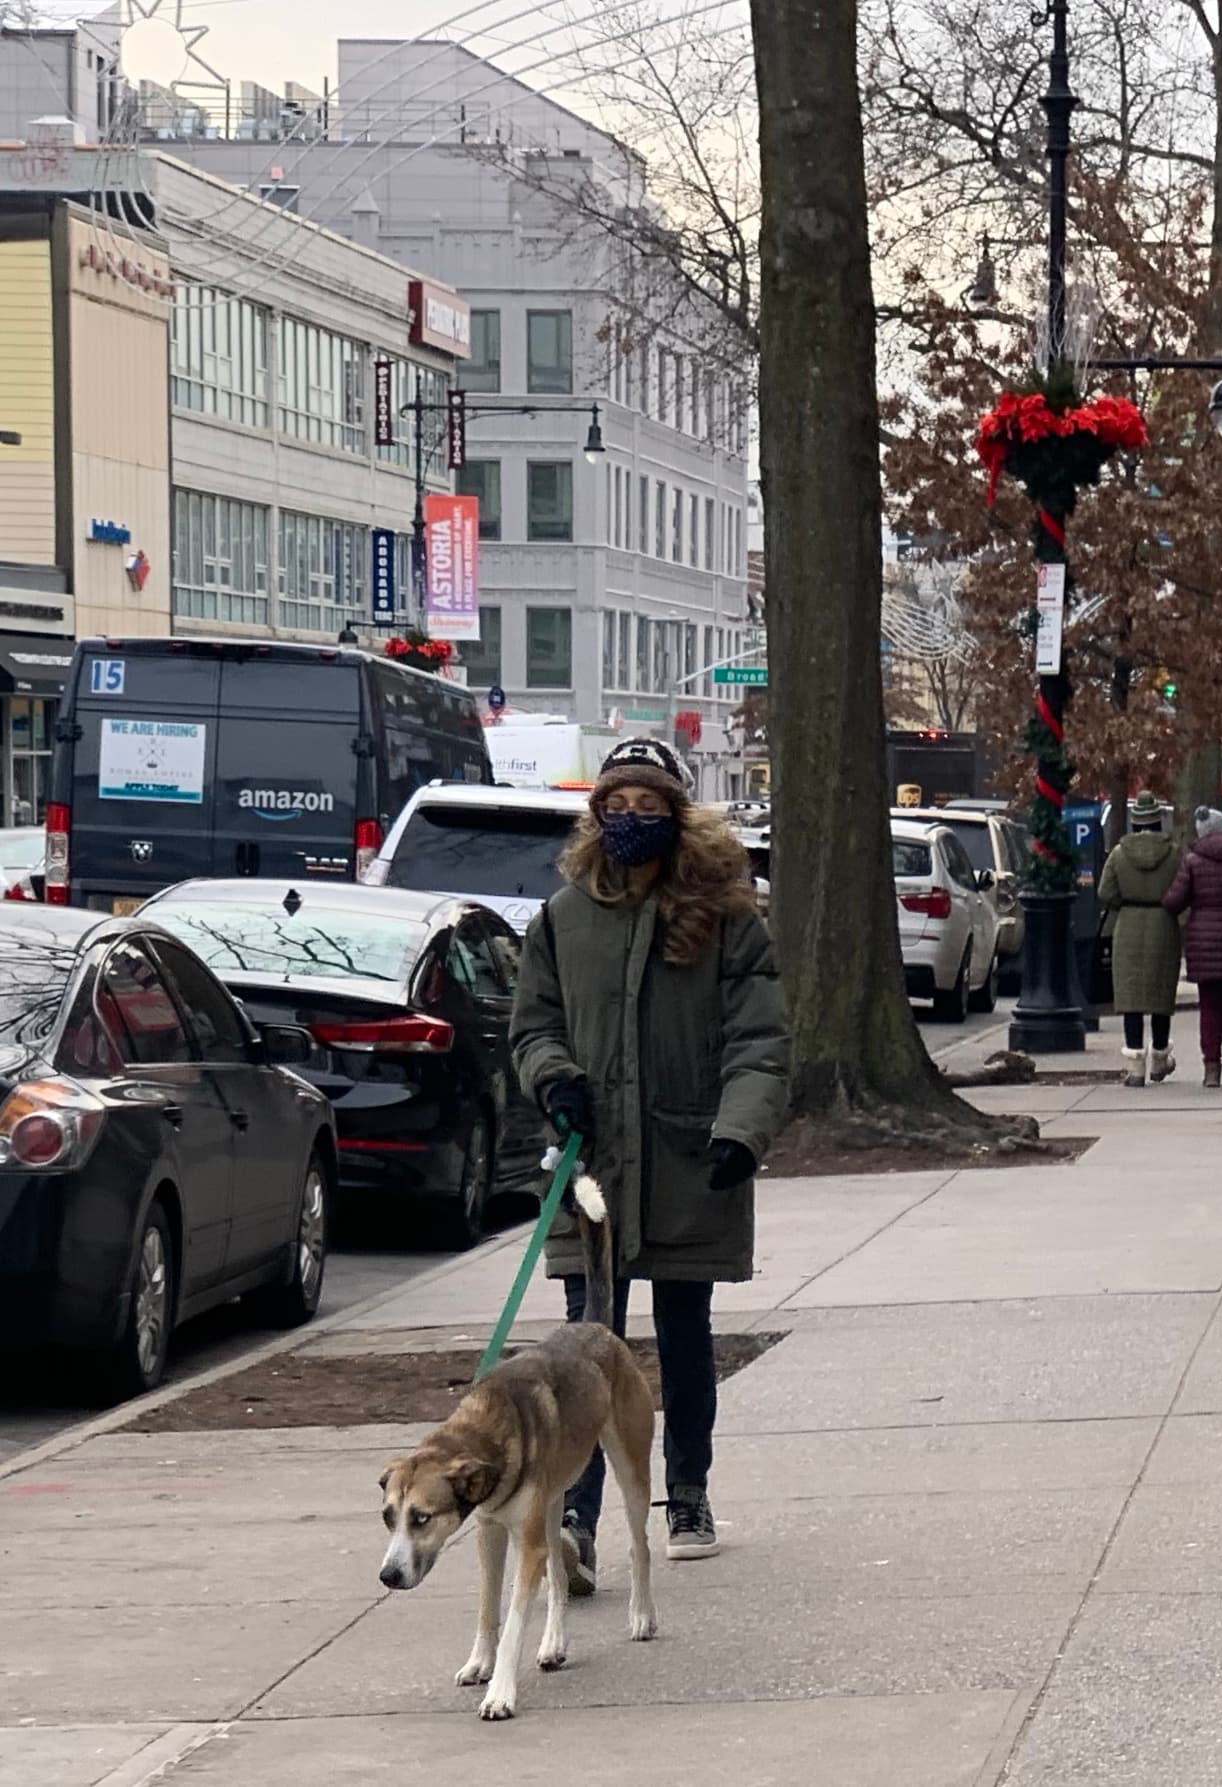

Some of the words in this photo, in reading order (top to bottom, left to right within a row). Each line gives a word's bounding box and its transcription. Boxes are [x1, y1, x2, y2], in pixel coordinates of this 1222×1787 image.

[378, 536, 388, 609] ABOGADO
[431, 520, 452, 610] ASTORIA
[93, 661, 123, 691] 15
[727, 671, 765, 681] Broad
[110, 722, 129, 734] WE
[131, 723, 153, 736] ARE
[156, 724, 198, 738] HIRING
[238, 789, 334, 811] amazon
[1075, 824, 1090, 845] P
